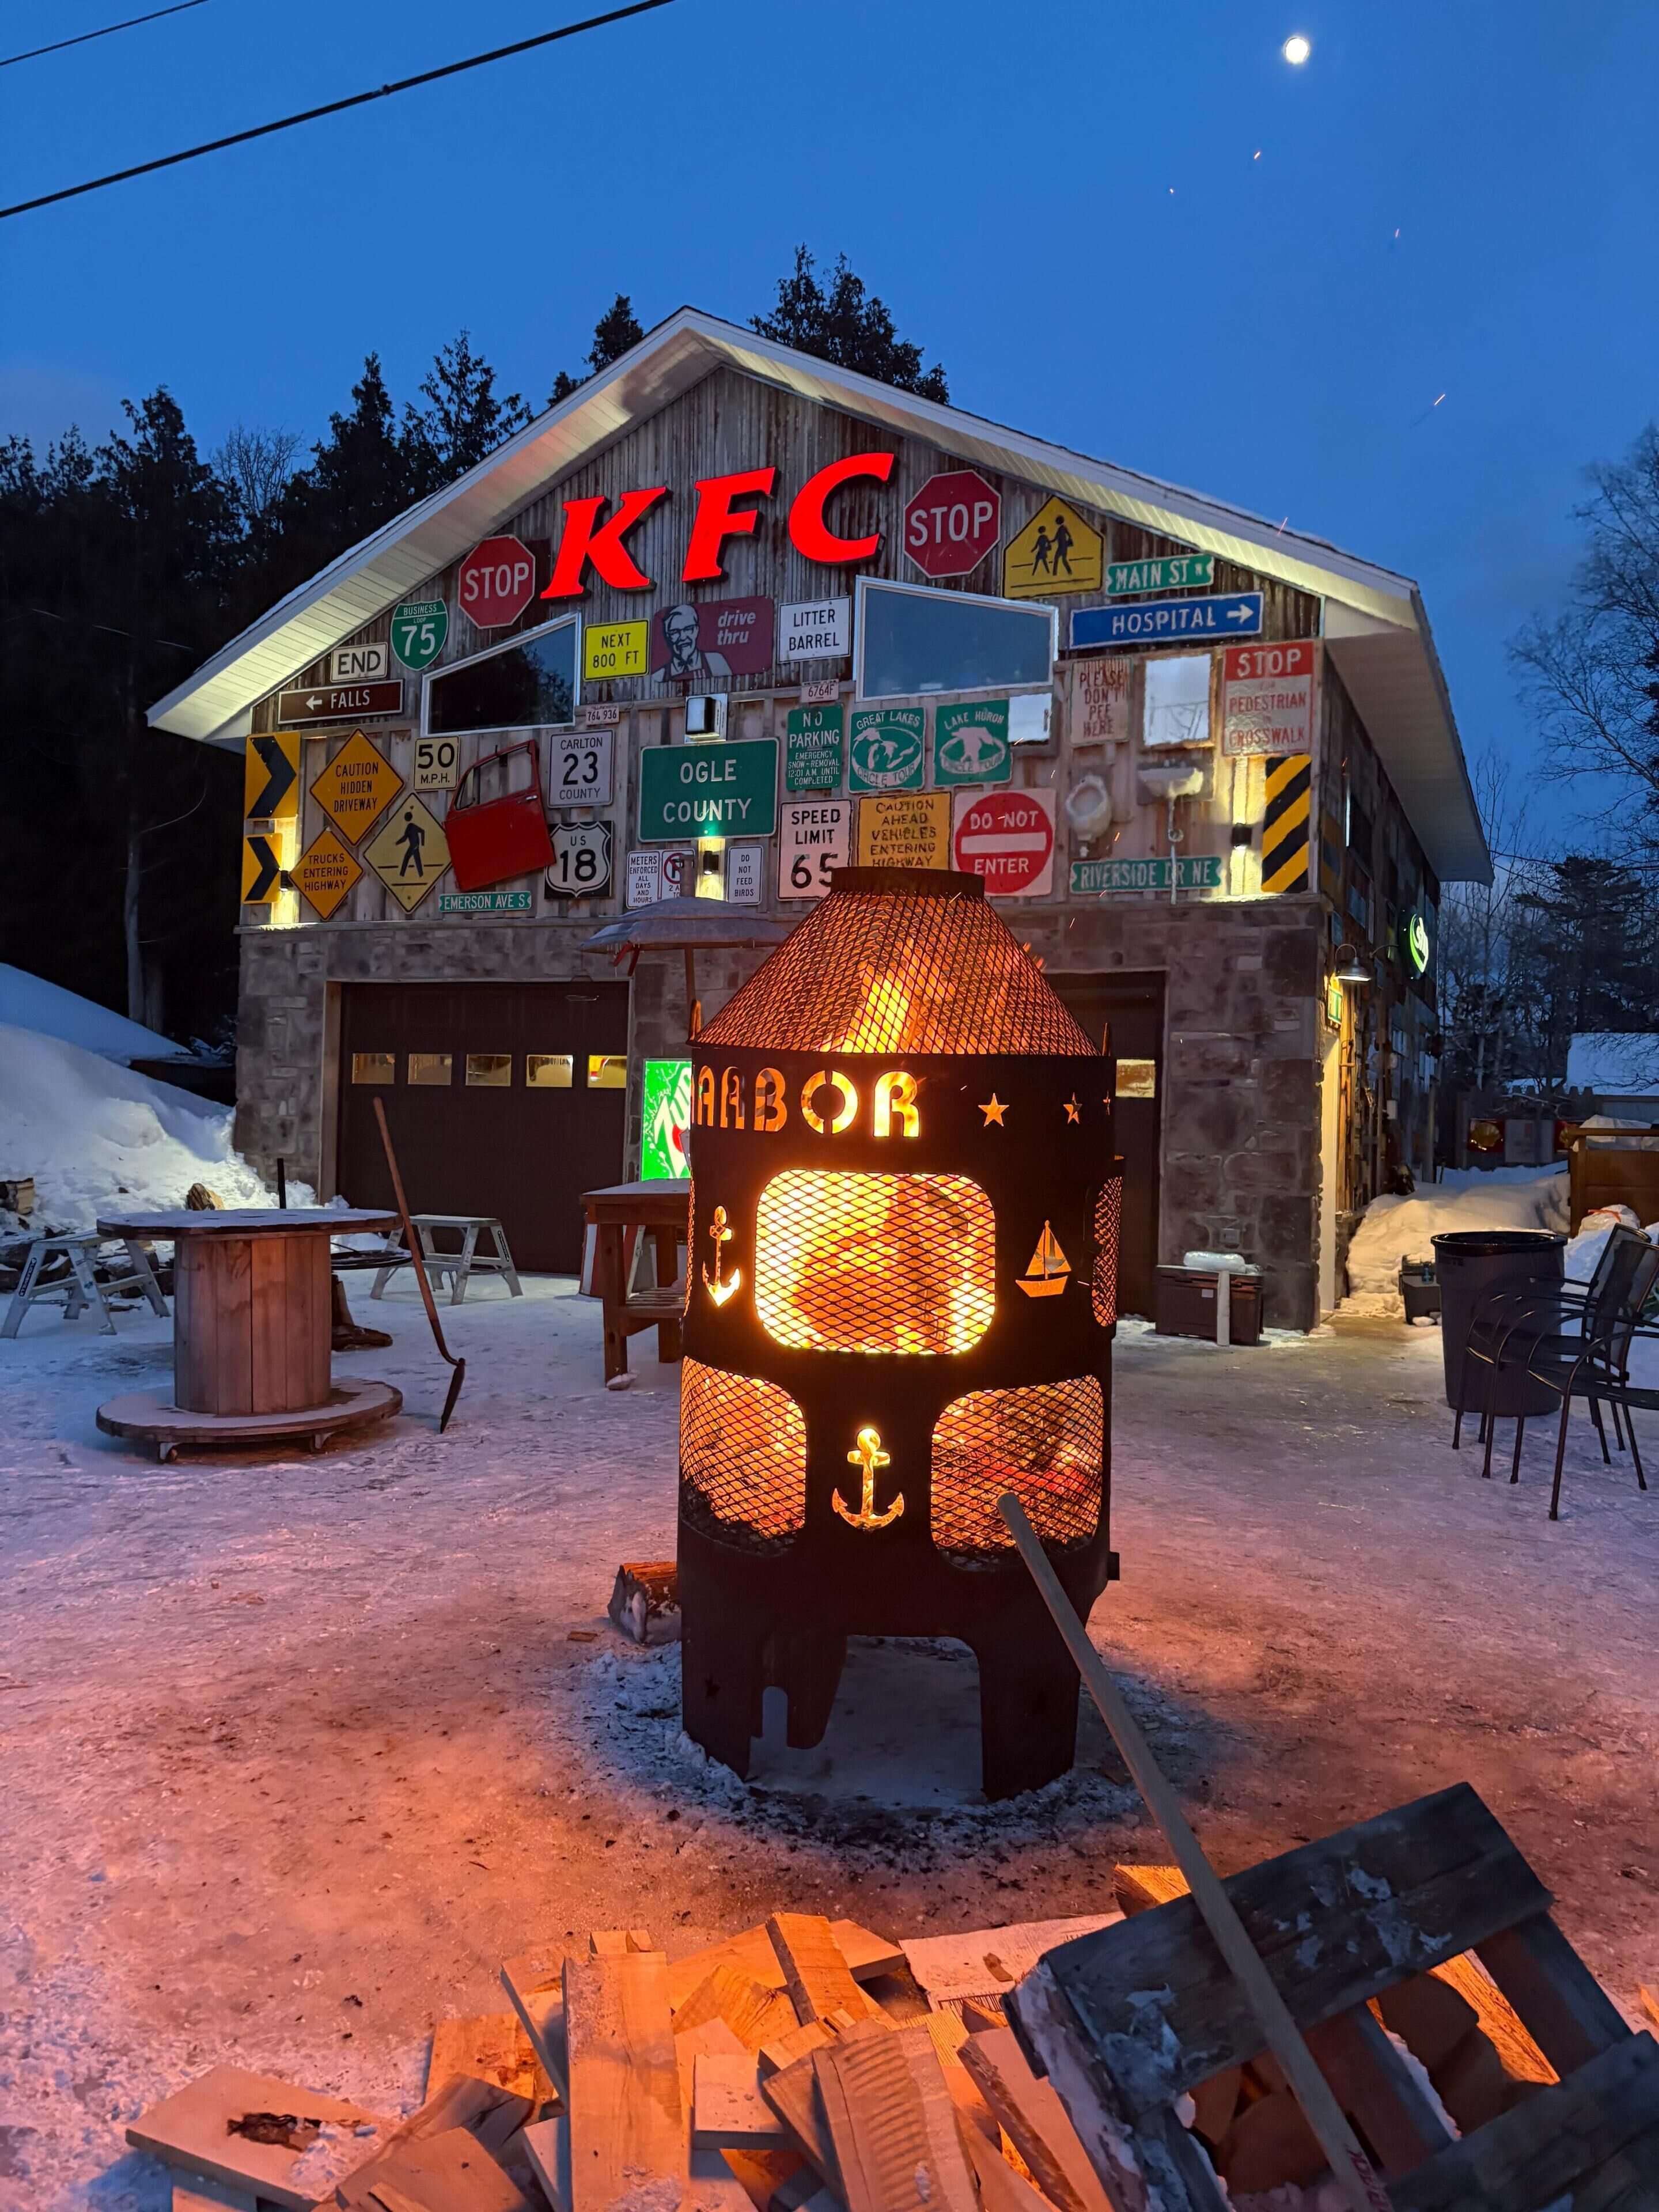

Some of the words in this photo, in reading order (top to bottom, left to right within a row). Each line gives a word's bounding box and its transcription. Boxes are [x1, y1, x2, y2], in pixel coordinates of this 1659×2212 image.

[540, 453, 895, 600] KFC
[909, 501, 993, 547] STOP
[464, 562, 529, 601] STOP
[1115, 563, 1162, 591] MAIN
[1169, 559, 1190, 584] ST
[403, 604, 437, 616] BUSINESS
[717, 609, 757, 628] drive
[793, 609, 835, 627] LITTER
[1112, 606, 1217, 635] HOSPITAL
[401, 623, 435, 657] 75
[601, 632, 631, 649] NEXT
[717, 628, 749, 646] thru
[789, 632, 840, 652] BARREL
[338, 650, 381, 675] END
[593, 654, 616, 668] 800
[625, 651, 639, 665] FT
[1237, 649, 1301, 677] STOP
[1080, 670, 1124, 689] PLEASE
[808, 684, 835, 697] 6764F
[331, 690, 370, 709] FALLS
[1229, 692, 1307, 713] PEDESTRIAN
[588, 710, 600, 721] 764
[603, 709, 617, 719] 936
[803, 711, 823, 728] NO
[856, 711, 885, 730] GREAT
[889, 710, 921, 728] LAKES
[944, 712, 969, 730] LAKE
[975, 710, 1004, 724] HURON
[1089, 703, 1111, 720] PEE
[1083, 719, 1114, 737] HERE
[1229, 725, 1305, 747] CROSSWALK
[560, 737, 603, 750] CARLTON
[789, 729, 839, 748] PARKING
[417, 742, 455, 770] 50
[795, 751, 833, 760] EMERGENCY
[980, 753, 1003, 770] TOUR
[335, 762, 379, 778] CAUTION
[562, 751, 599, 785] 23
[680, 759, 737, 784] OGLE
[788, 768, 803, 778] 12:01
[821, 766, 839, 775] UNTIL
[857, 766, 887, 785] CIRCLE
[893, 764, 916, 782] TOUR
[420, 772, 450, 785] M.P.H.
[794, 775, 833, 786] COMPLETED
[340, 780, 372, 795] HIDDEN
[559, 787, 601, 800] COUNTY
[334, 797, 378, 813] DRIVEWAY
[663, 798, 752, 823] COUNTY
[876, 799, 934, 814] CAUTION
[791, 809, 841, 825] SPEED
[881, 813, 927, 826] AHEAD
[969, 813, 993, 830] DO
[1003, 810, 1039, 828] NOT
[570, 836, 586, 846] US
[795, 829, 835, 844] LIMIT
[872, 826, 937, 841] VEHICLES
[870, 842, 935, 856] ENTERING
[308, 853, 345, 865] TRUCKS
[560, 849, 597, 882] 18
[630, 855, 657, 865] METERS
[872, 855, 933, 868] HIGHWAY
[974, 858, 1029, 876] ENTER
[304, 866, 349, 878] ENTERING
[629, 864, 658, 874] ENFORCED
[791, 853, 838, 889] 65
[1080, 862, 1156, 889] RIVERSIDE
[1192, 861, 1212, 884] NE
[304, 878, 346, 892] HIGHWAY
[737, 877, 753, 885] FEED
[444, 895, 491, 910] EMERSON
[495, 893, 514, 908] AVE
[518, 893, 525, 908] S
[734, 889, 754, 897] BIRDS
[691, 1065, 921, 1138] ARBOR
